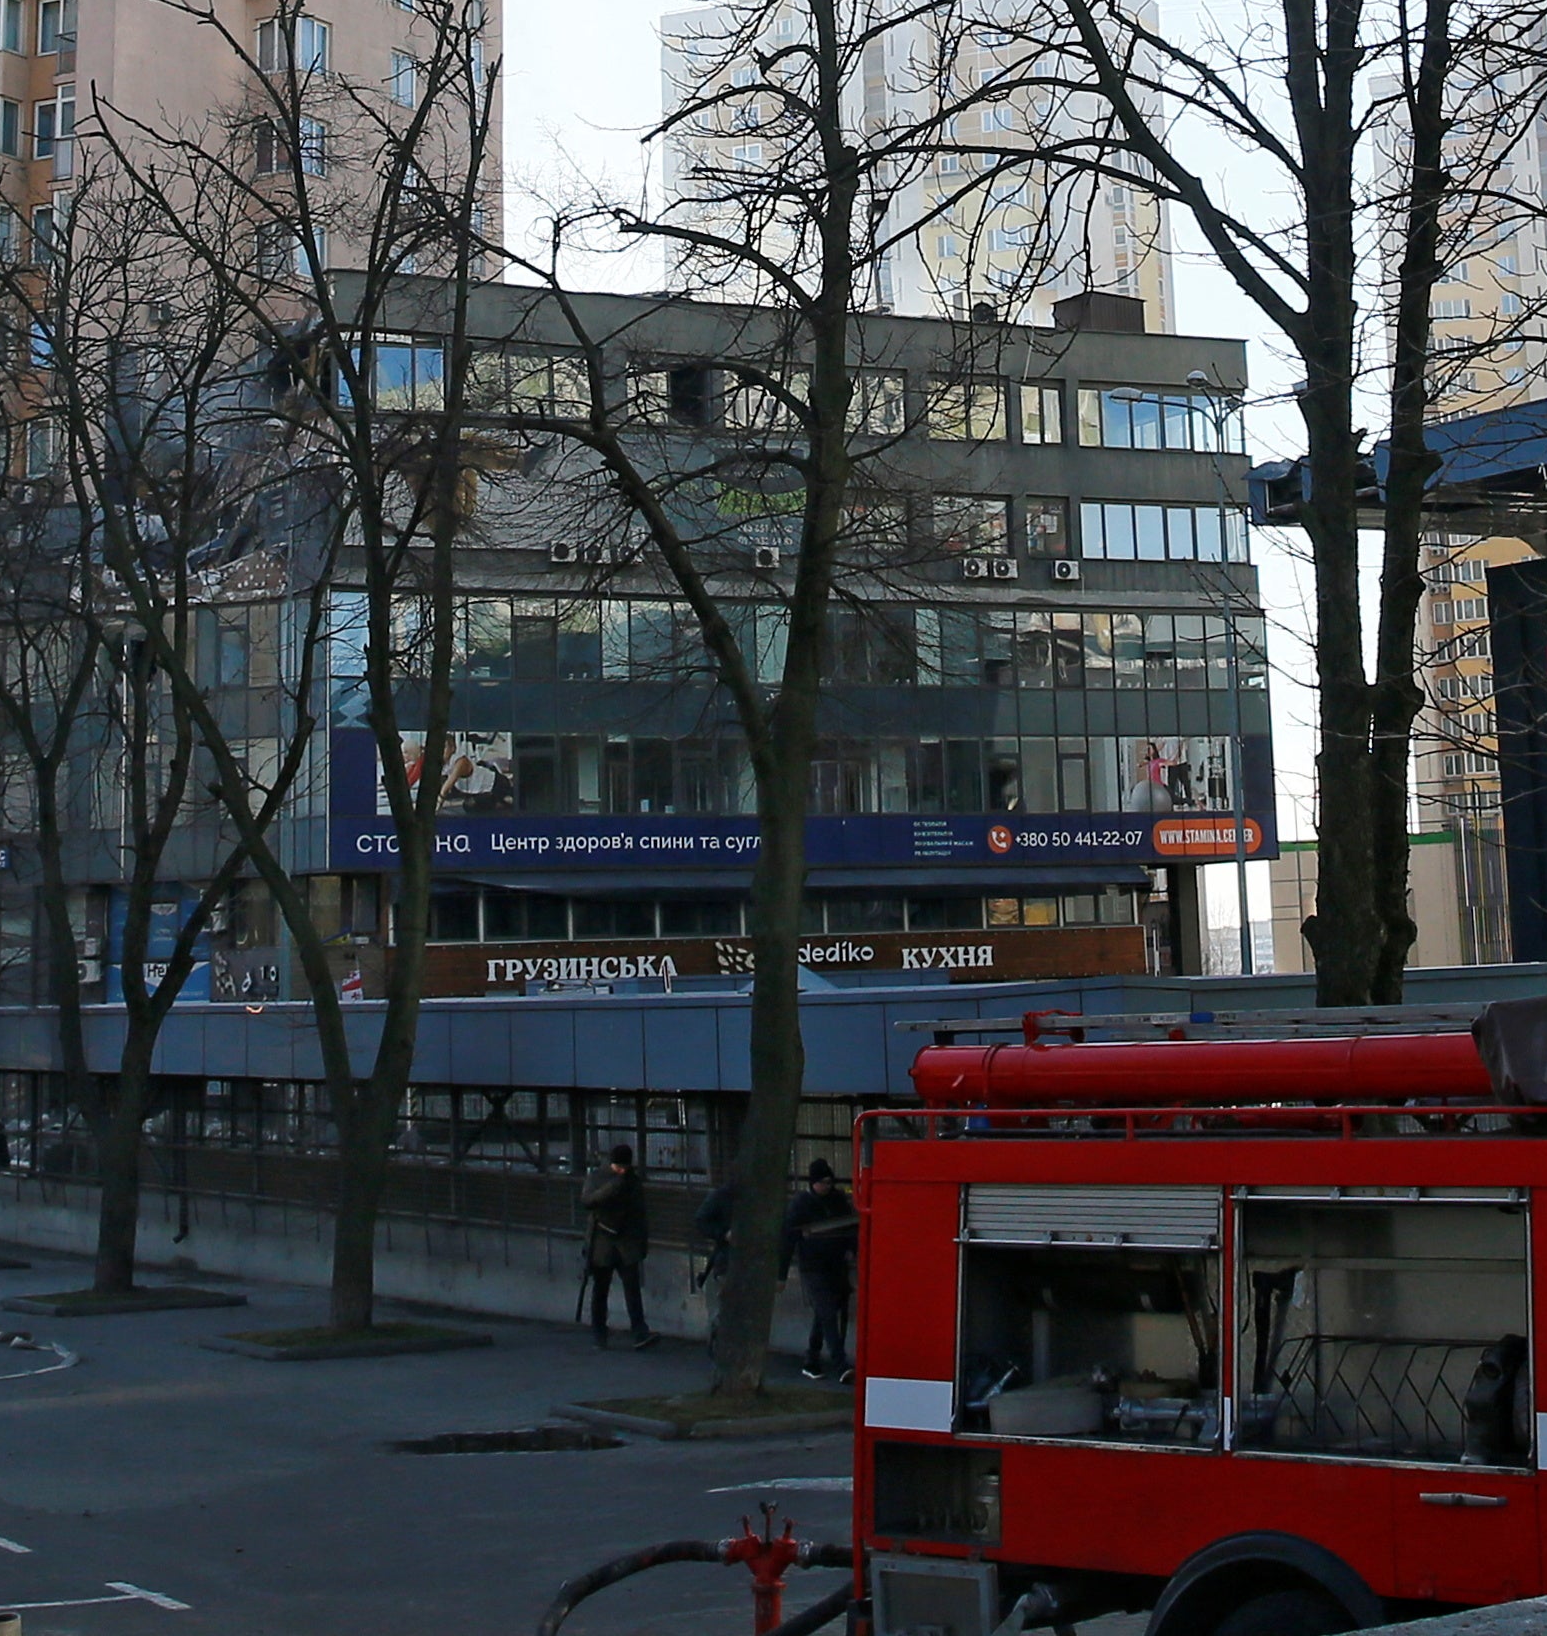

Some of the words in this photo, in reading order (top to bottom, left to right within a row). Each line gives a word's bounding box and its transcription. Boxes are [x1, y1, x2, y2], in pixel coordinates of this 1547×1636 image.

[491, 833, 550, 854] Центр
[555, 832, 634, 854] здоров'я
[639, 836, 694, 849] спини
[699, 836, 720, 849] та
[1015, 832, 1048, 847] +380
[1051, 831, 1071, 847] 50
[1074, 830, 1143, 847] 441-22-07
[1159, 827, 1254, 845] WWW.STAMINA.CEER
[486, 954, 678, 982] ГРУЗИНСЬКА
[901, 945, 994, 970] КУХНЯ
